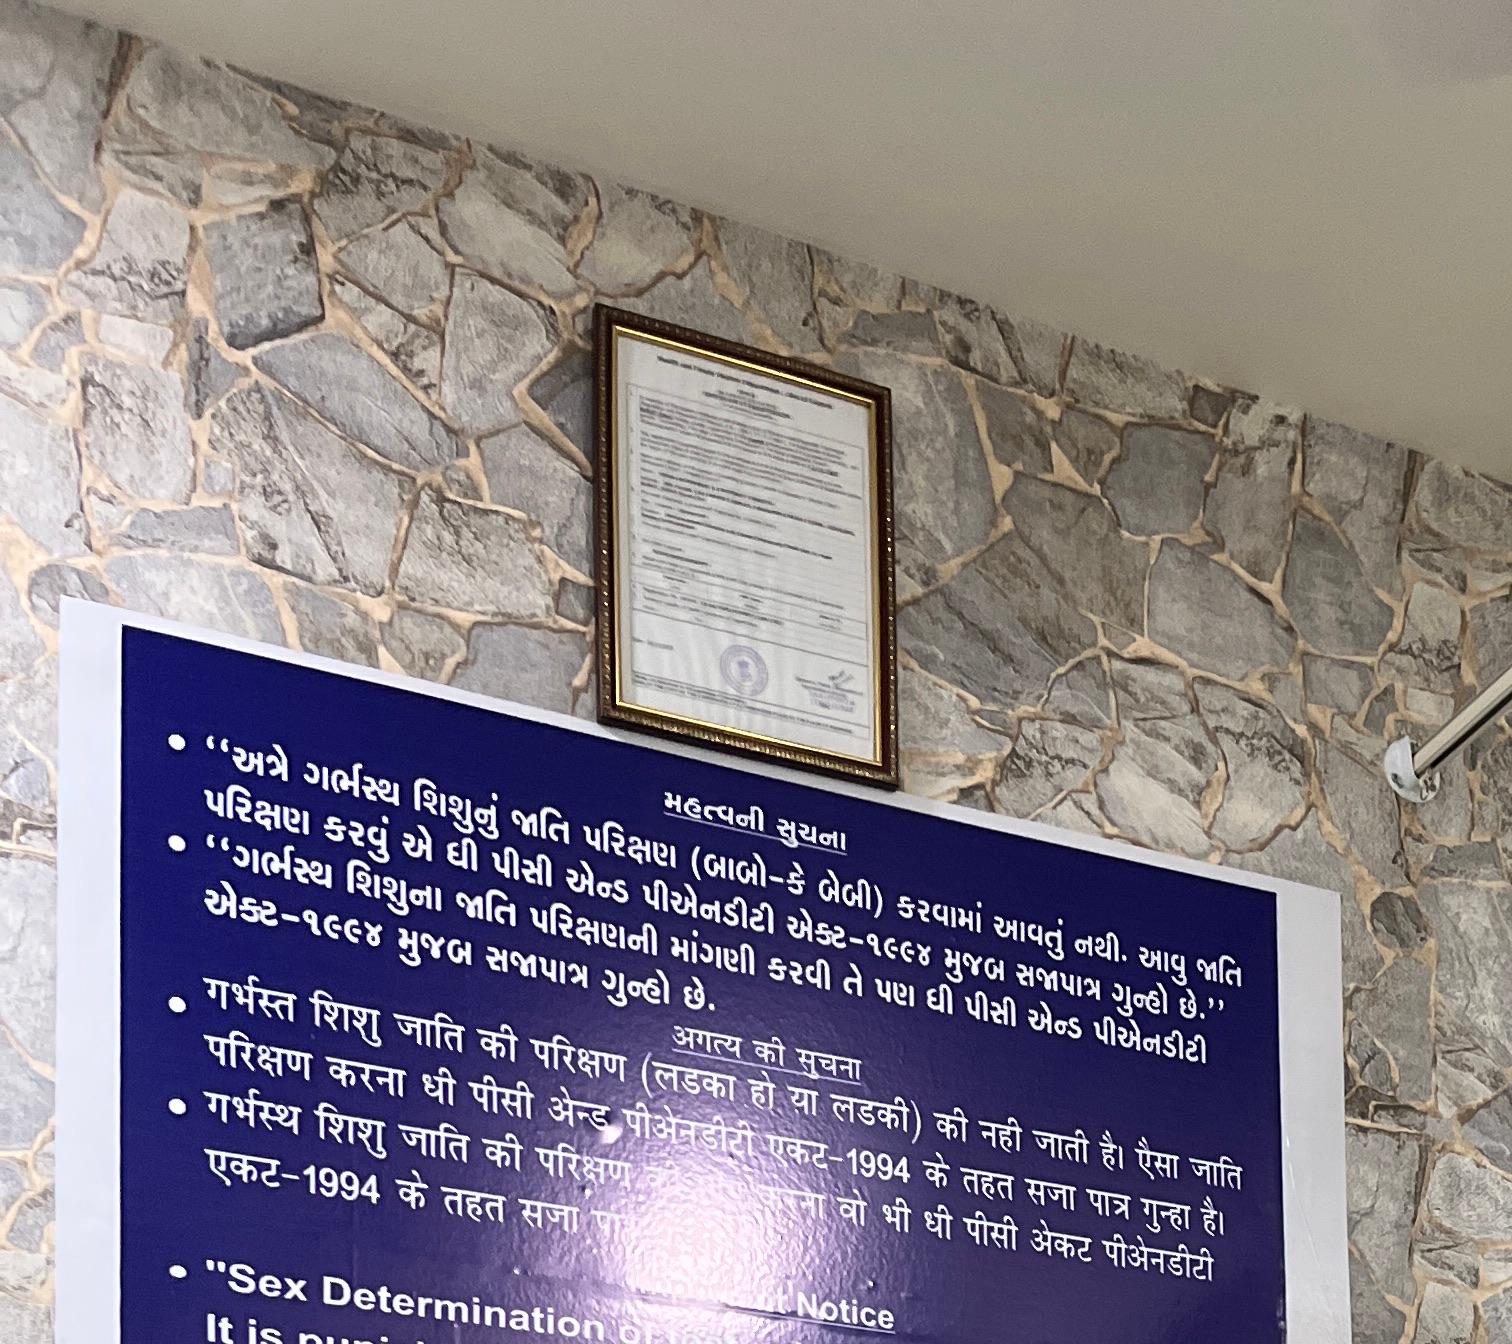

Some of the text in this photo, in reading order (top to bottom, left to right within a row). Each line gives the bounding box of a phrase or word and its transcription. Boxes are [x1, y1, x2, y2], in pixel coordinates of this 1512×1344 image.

[302, 761, 400, 806] ગર્ભસ્થ
[413, 777, 499, 840] શિશુનું
[510, 806, 569, 845] જાતિ
[582, 820, 676, 868] પરિક્ષણ
[690, 845, 806, 895] (બાબો-કે
[817, 868, 883, 919] બેબી)
[896, 895, 982, 933] કરવામાં
[992, 915, 1064, 961] આવતું
[1073, 931, 1127, 962] નથી.
[1138, 945, 1187, 986] આવુ
[1195, 954, 1242, 987] જાતિ
[775, 817, 846, 851] સુચના
[203, 783, 309, 835] પરિક્ષણ
[322, 814, 390, 863] કરવું
[401, 823, 432, 862] એ
[491, 845, 552, 887] પીસી
[565, 859, 629, 903] એન્ડ
[943, 947, 1004, 983] મુજબ
[1015, 962, 1100, 1001] સજાપાત્ર
[346, 858, 442, 916] શિશુના
[455, 888, 516, 927] જાતિ
[529, 902, 657, 956] પરિક્ષણની
[669, 929, 754, 976] માંગણી
[767, 956, 831, 991] કરવી
[842, 961, 863, 997] તે
[873, 977, 914, 1007] પણ
[964, 990, 1016, 1027] પીસી
[1027, 1000, 1082, 1039] એન્ડ
[397, 927, 472, 967] મુજબ
[484, 945, 588, 988] સજાપાત્ર
[683, 975, 715, 1011] છે.
[201, 974, 297, 1022] गर्भस्त
[307, 989, 382, 1048] शिशु
[391, 1011, 465, 1053] जाति
[475, 1022, 518, 1063] की
[528, 1033, 627, 1082] परिक्षण
[640, 1051, 737, 1101] (लडका
[746, 1069, 776, 1110] हो
[787, 1087, 818, 1117] या
[829, 1093, 921, 1144] लडकी)
[932, 1106, 969, 1142] की
[977, 1116, 1023, 1153] नही
[1031, 1128, 1090, 1164] जाती
[1133, 1135, 1180, 1180] ऐसा
[1188, 1155, 1243, 1190] जाति
[671, 1024, 862, 1080] अगत्य की सुचना
[202, 1029, 314, 1081] परिक्षण
[324, 1055, 407, 1098] करना
[421, 1066, 457, 1106] धी
[467, 1073, 535, 1120] पीसी
[921, 1151, 950, 1188] के
[959, 1166, 1014, 1201] तहत
[1023, 1177, 1077, 1211] सजा
[1084, 1187, 1132, 1220] पात्र
[1139, 1197, 1191, 1233] गुन्हा
[202, 1087, 302, 1135] गर्भस्थ
[312, 1101, 387, 1159] शिशु
[397, 1121, 471, 1163] जाति
[481, 1132, 524, 1172] की
[535, 1141, 631, 1194] परिक्षण
[836, 1187, 867, 1227] वो
[881, 1196, 912, 1233] भी
[923, 1203, 953, 1240] धी
[962, 1209, 1019, 1251] पीसी
[203, 1147, 380, 1204] एकट-1994
[394, 1168, 428, 1209] के
[439, 1185, 507, 1223] तहत
[517, 1199, 580, 1235] सजा
[206, 1312, 234, 1344] It
[323, 1276, 604, 1342] Determination
[797, 1293, 894, 1330] Notice
